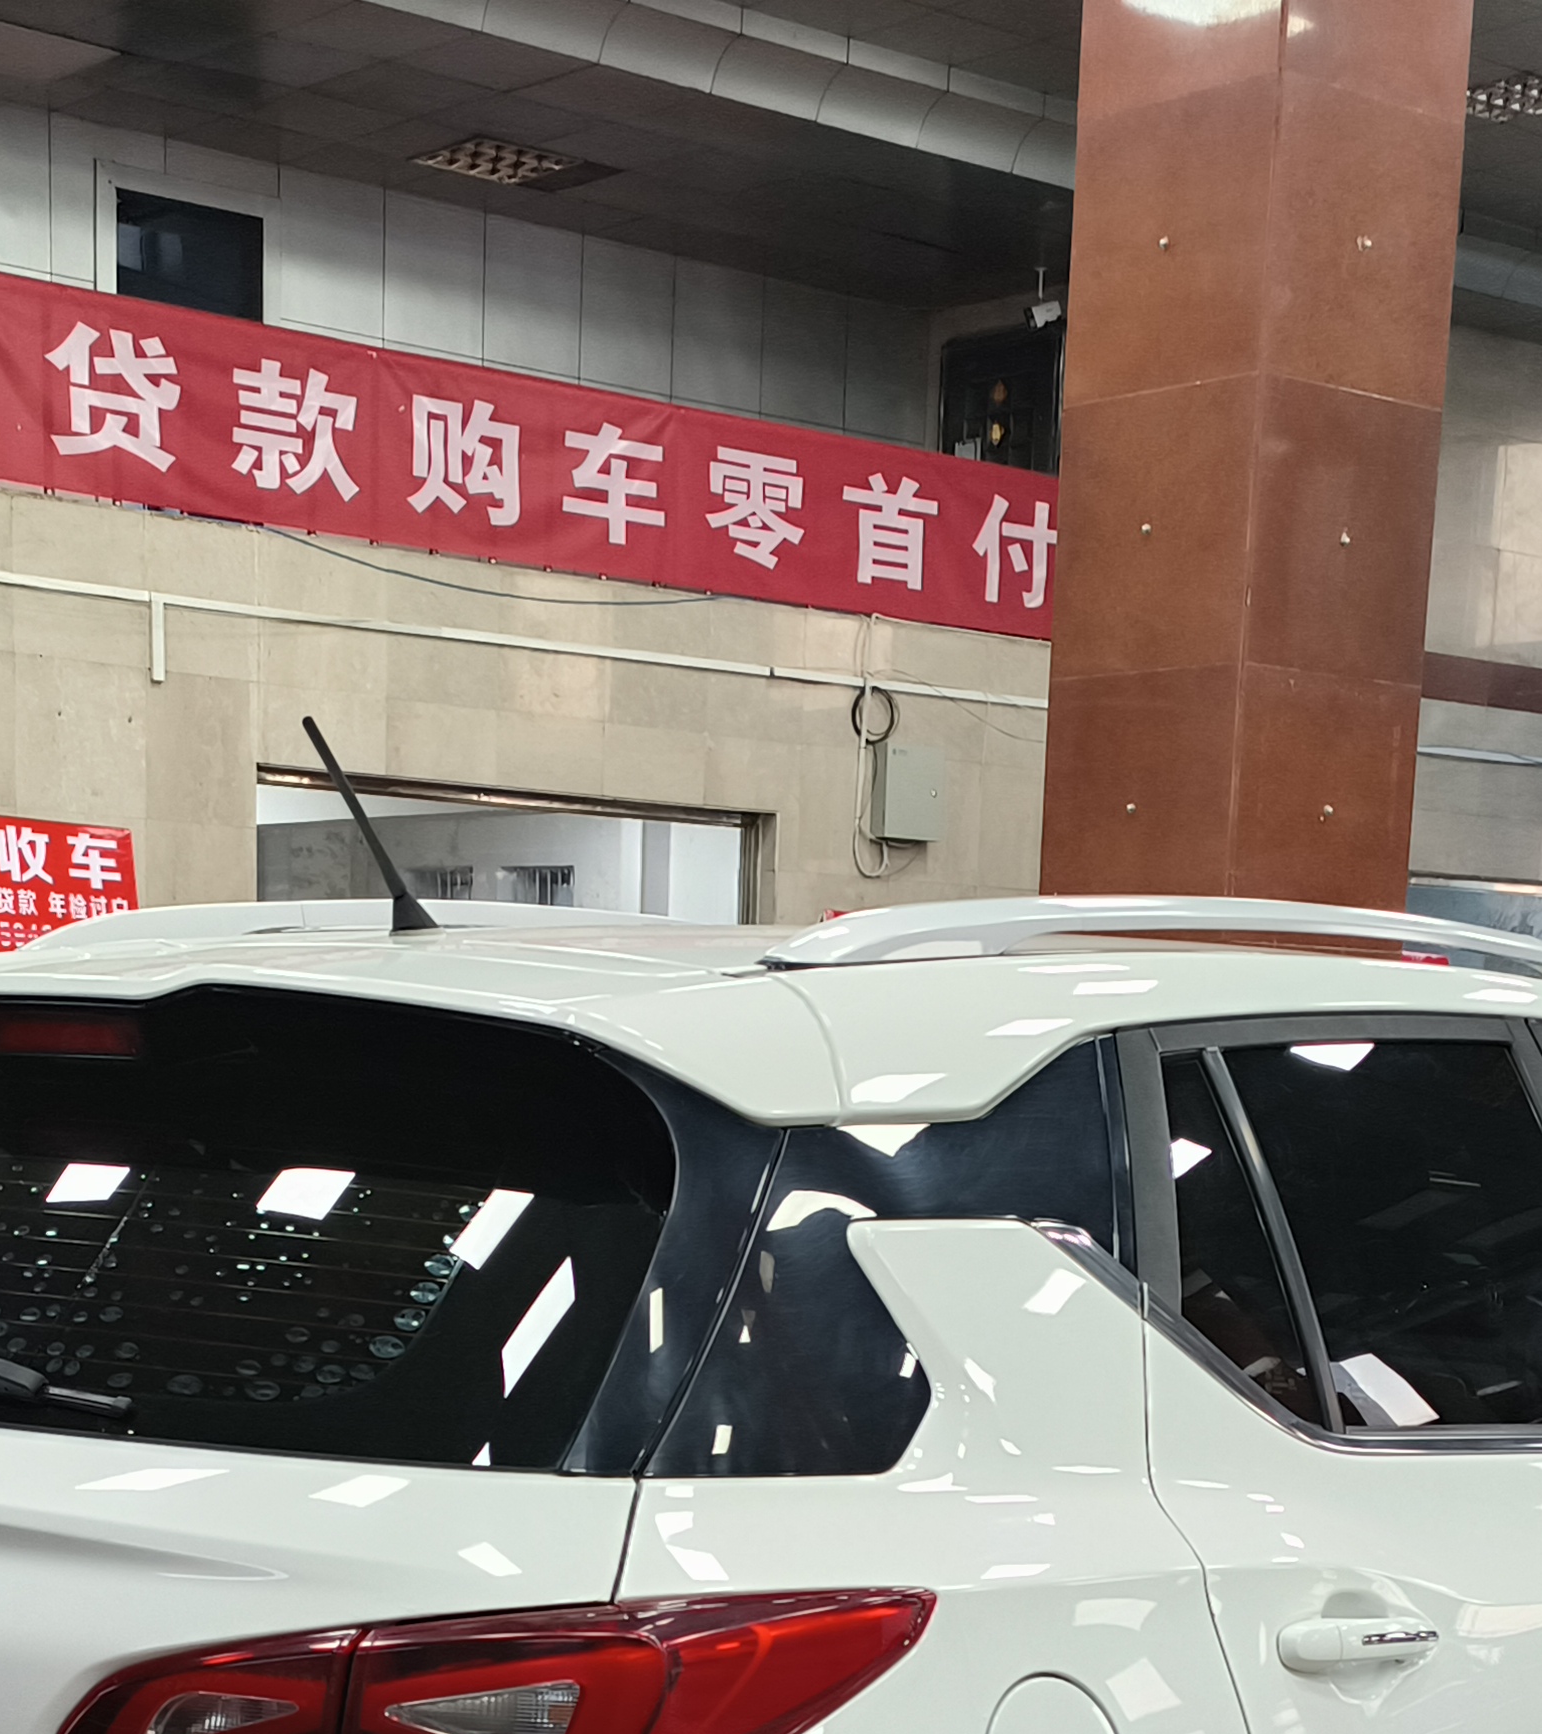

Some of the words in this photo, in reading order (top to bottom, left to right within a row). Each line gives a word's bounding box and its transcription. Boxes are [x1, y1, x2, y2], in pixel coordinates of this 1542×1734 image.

[45, 320, 1058, 609] 贷款购车零首付
